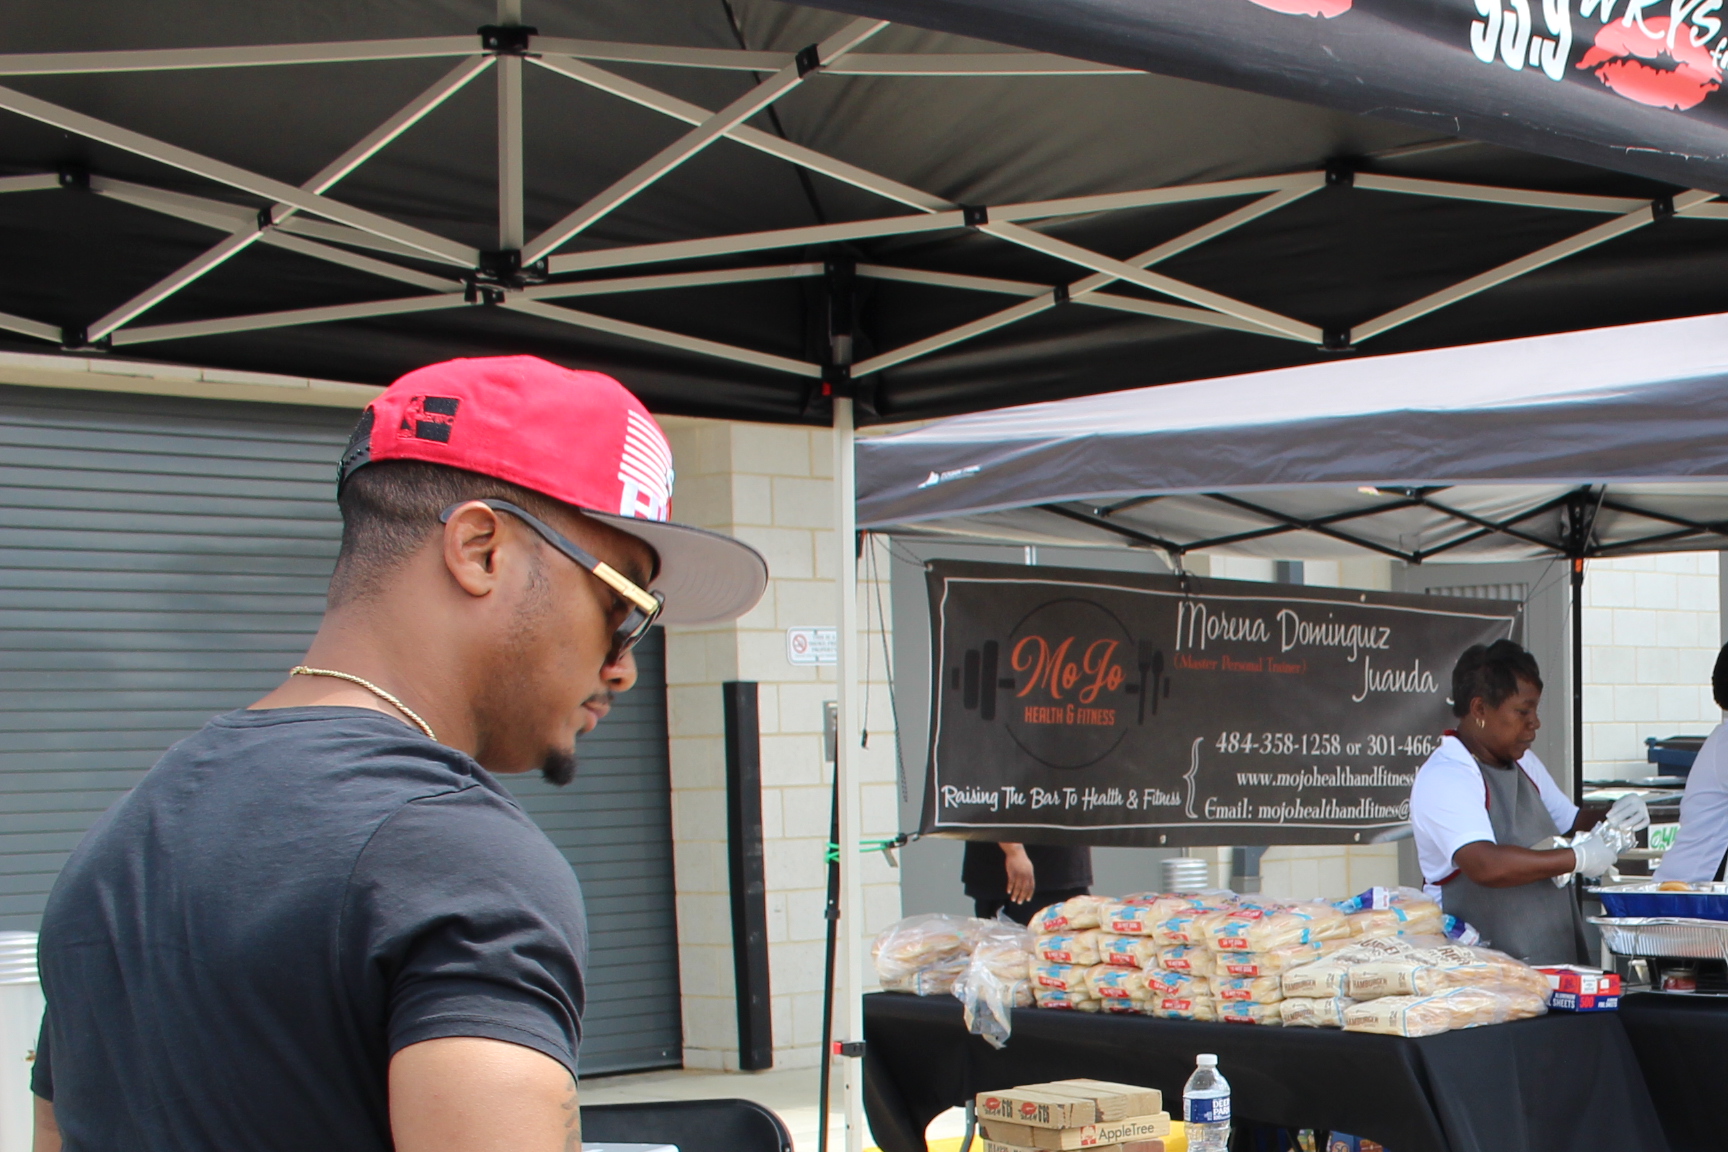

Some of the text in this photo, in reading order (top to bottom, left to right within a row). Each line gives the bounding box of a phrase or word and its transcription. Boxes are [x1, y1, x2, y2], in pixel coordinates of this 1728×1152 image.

[1175, 600, 1391, 662] Morena Dominguez
[1011, 635, 1126, 704] MoJo
[1352, 655, 1438, 703] Juanda
[1024, 705, 1063, 724] HEALTH
[1077, 708, 1116, 726] FITNESS
[1215, 732, 1341, 755] 484-358-1258
[1346, 741, 1362, 756] or
[941, 783, 1182, 812] Raising The Bar To Health & Fitness
[1204, 797, 1411, 823] Email: mojohealthandfitness@
[1098, 1122, 1155, 1141] AppleTree
